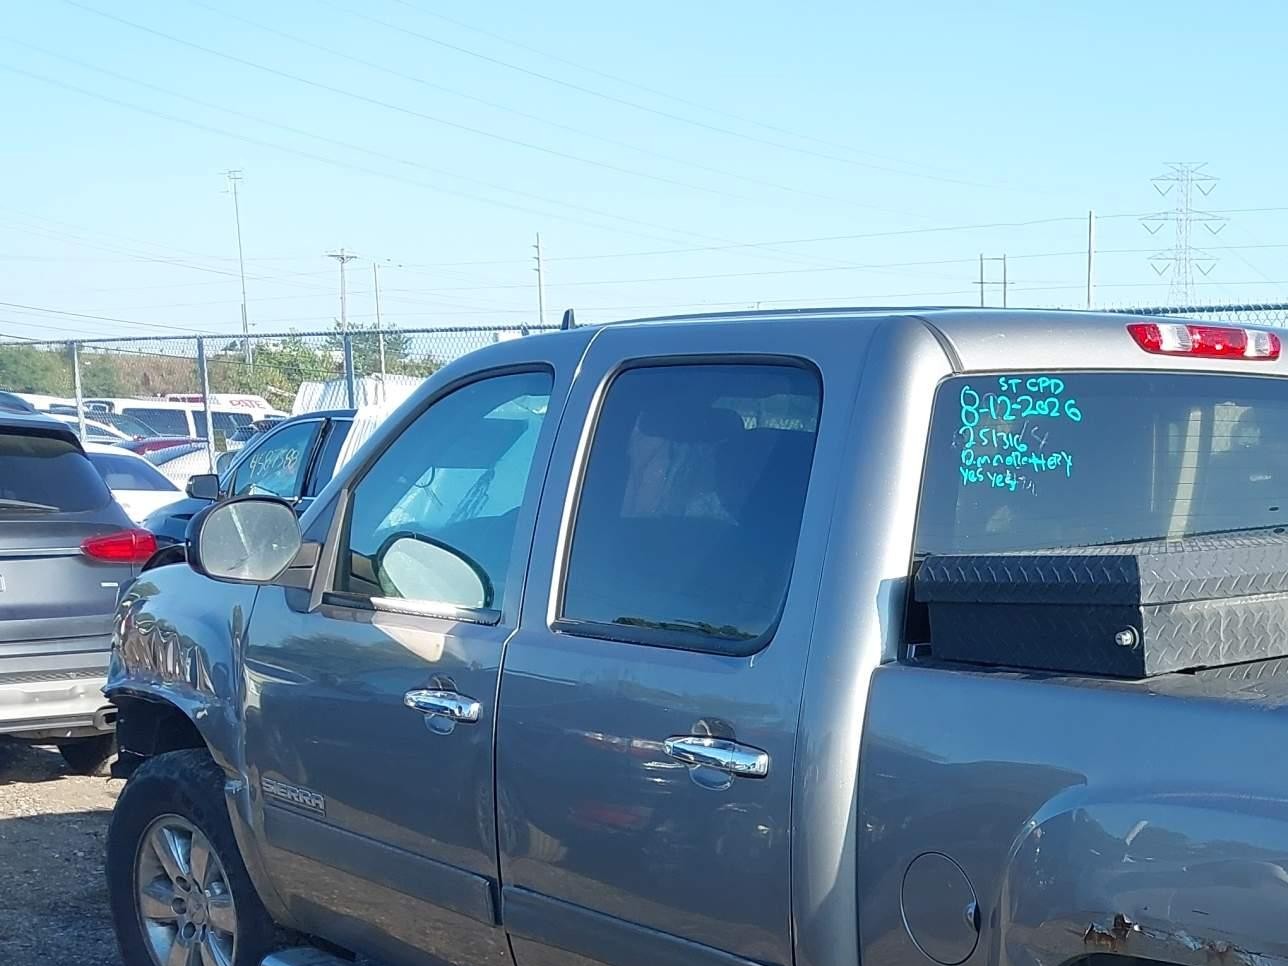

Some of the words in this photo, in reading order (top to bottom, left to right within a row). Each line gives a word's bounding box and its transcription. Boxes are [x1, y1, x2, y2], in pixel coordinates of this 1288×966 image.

[1026, 376, 1064, 394] CPD
[960, 385, 1081, 427] 8-12-2026
[262, 777, 325, 811] SIERRA
